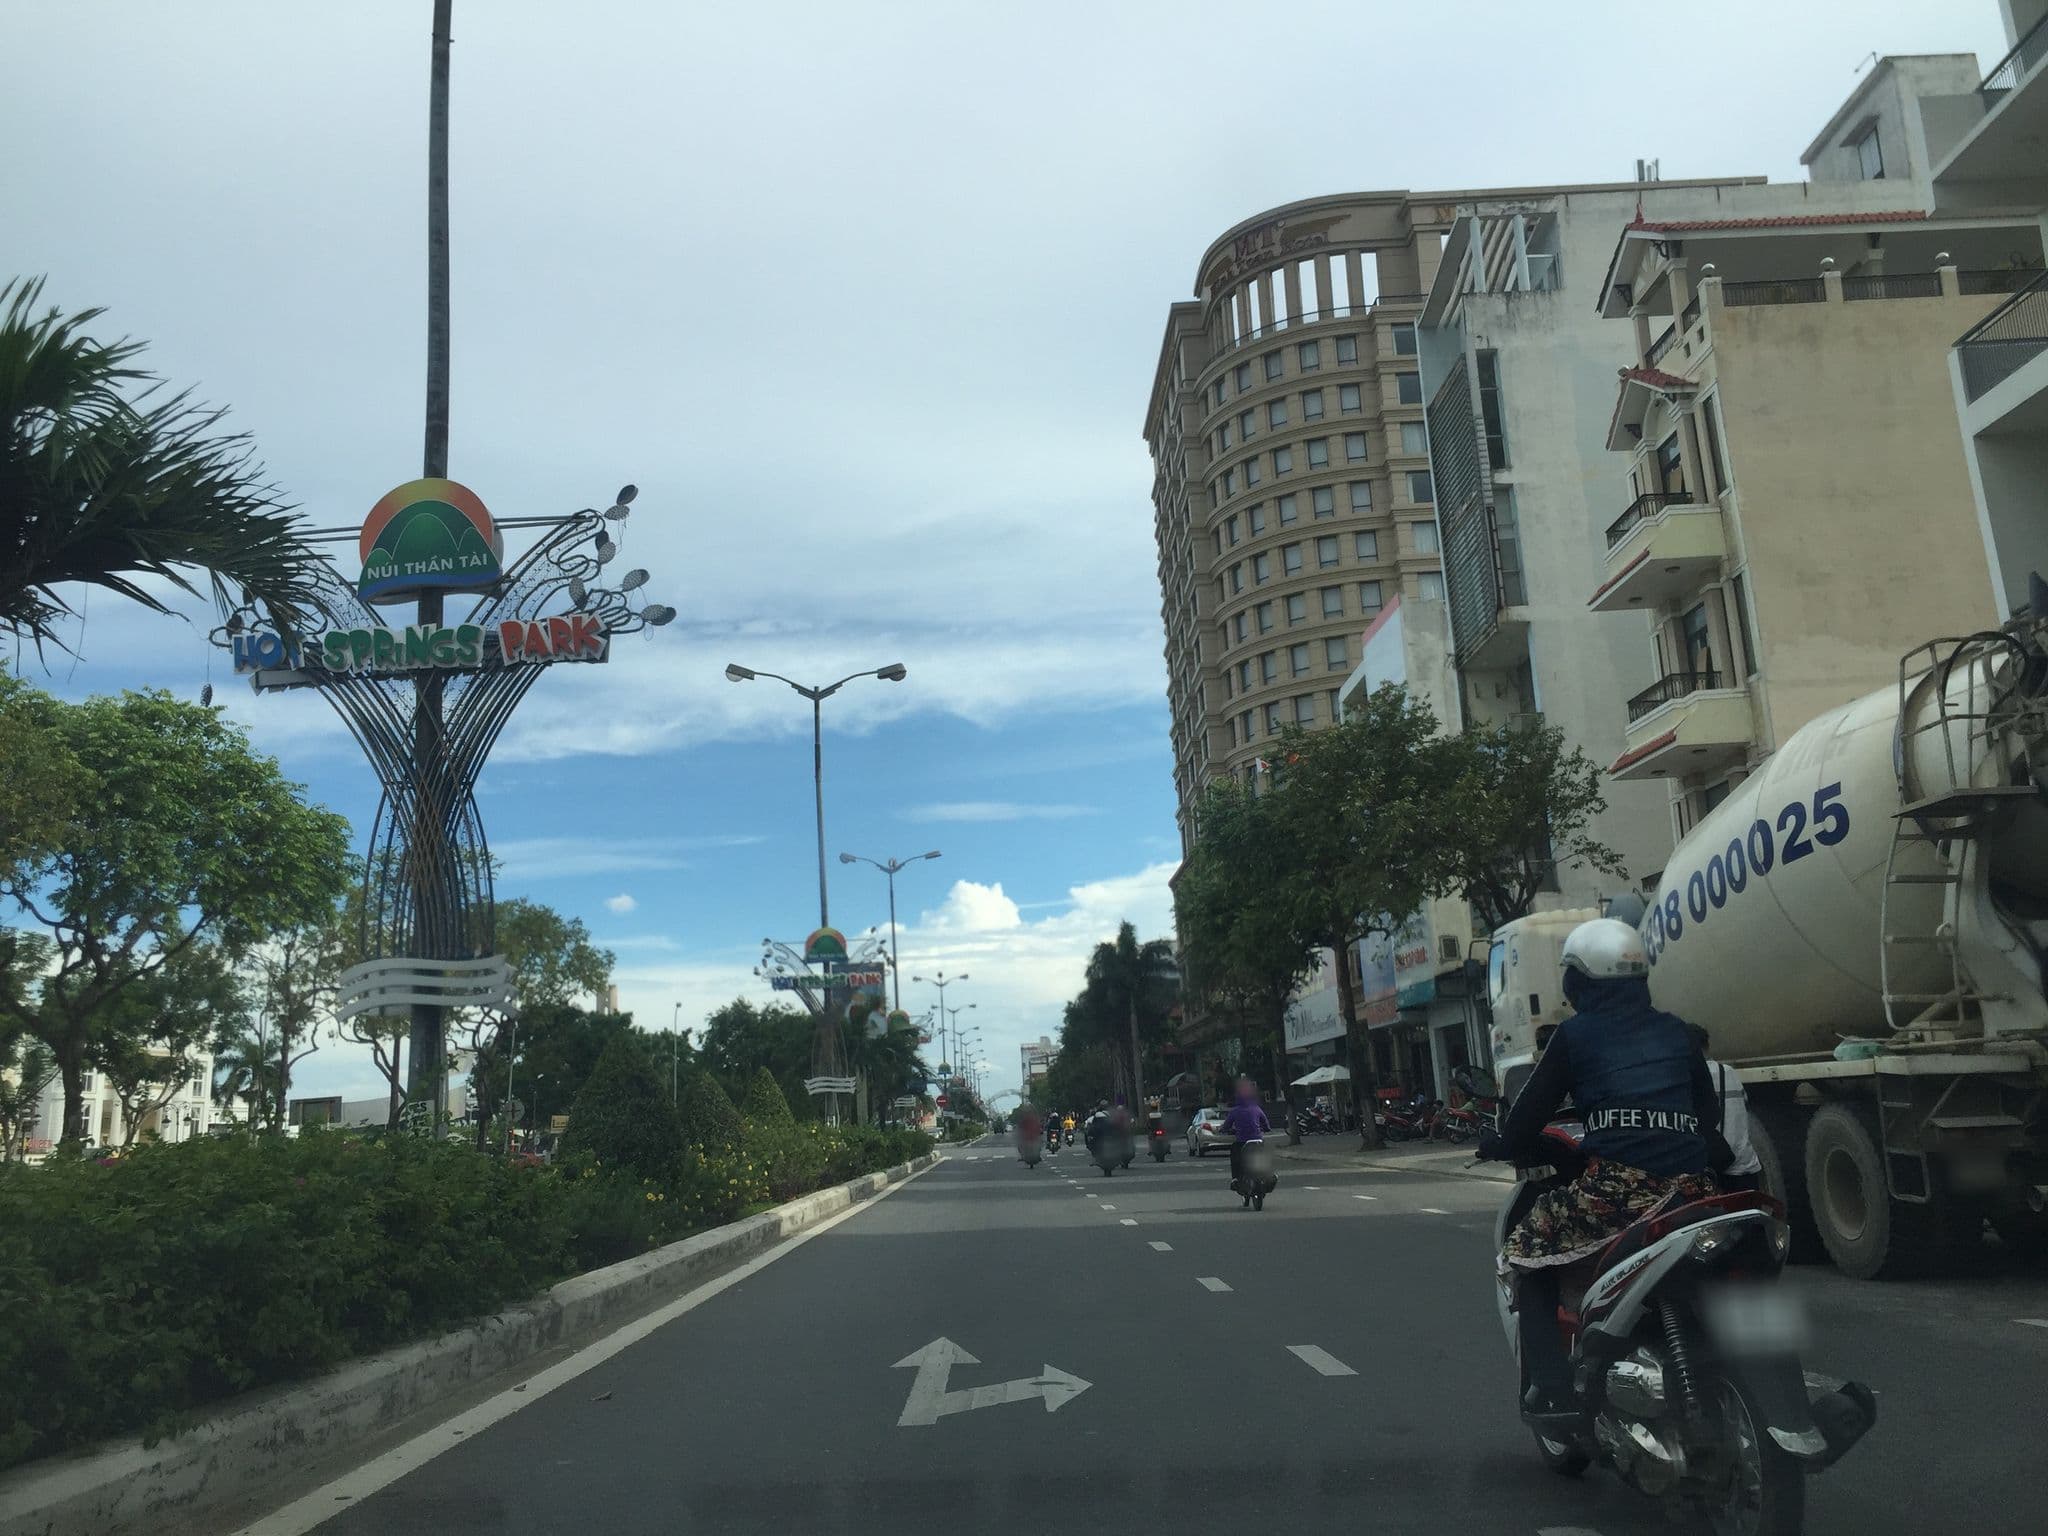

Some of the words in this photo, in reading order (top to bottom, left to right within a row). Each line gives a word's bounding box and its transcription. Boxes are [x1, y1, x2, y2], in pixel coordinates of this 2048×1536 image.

[367, 562, 399, 579] NÚI
[459, 551, 487, 568] TÀI
[500, 612, 607, 665] PARK
